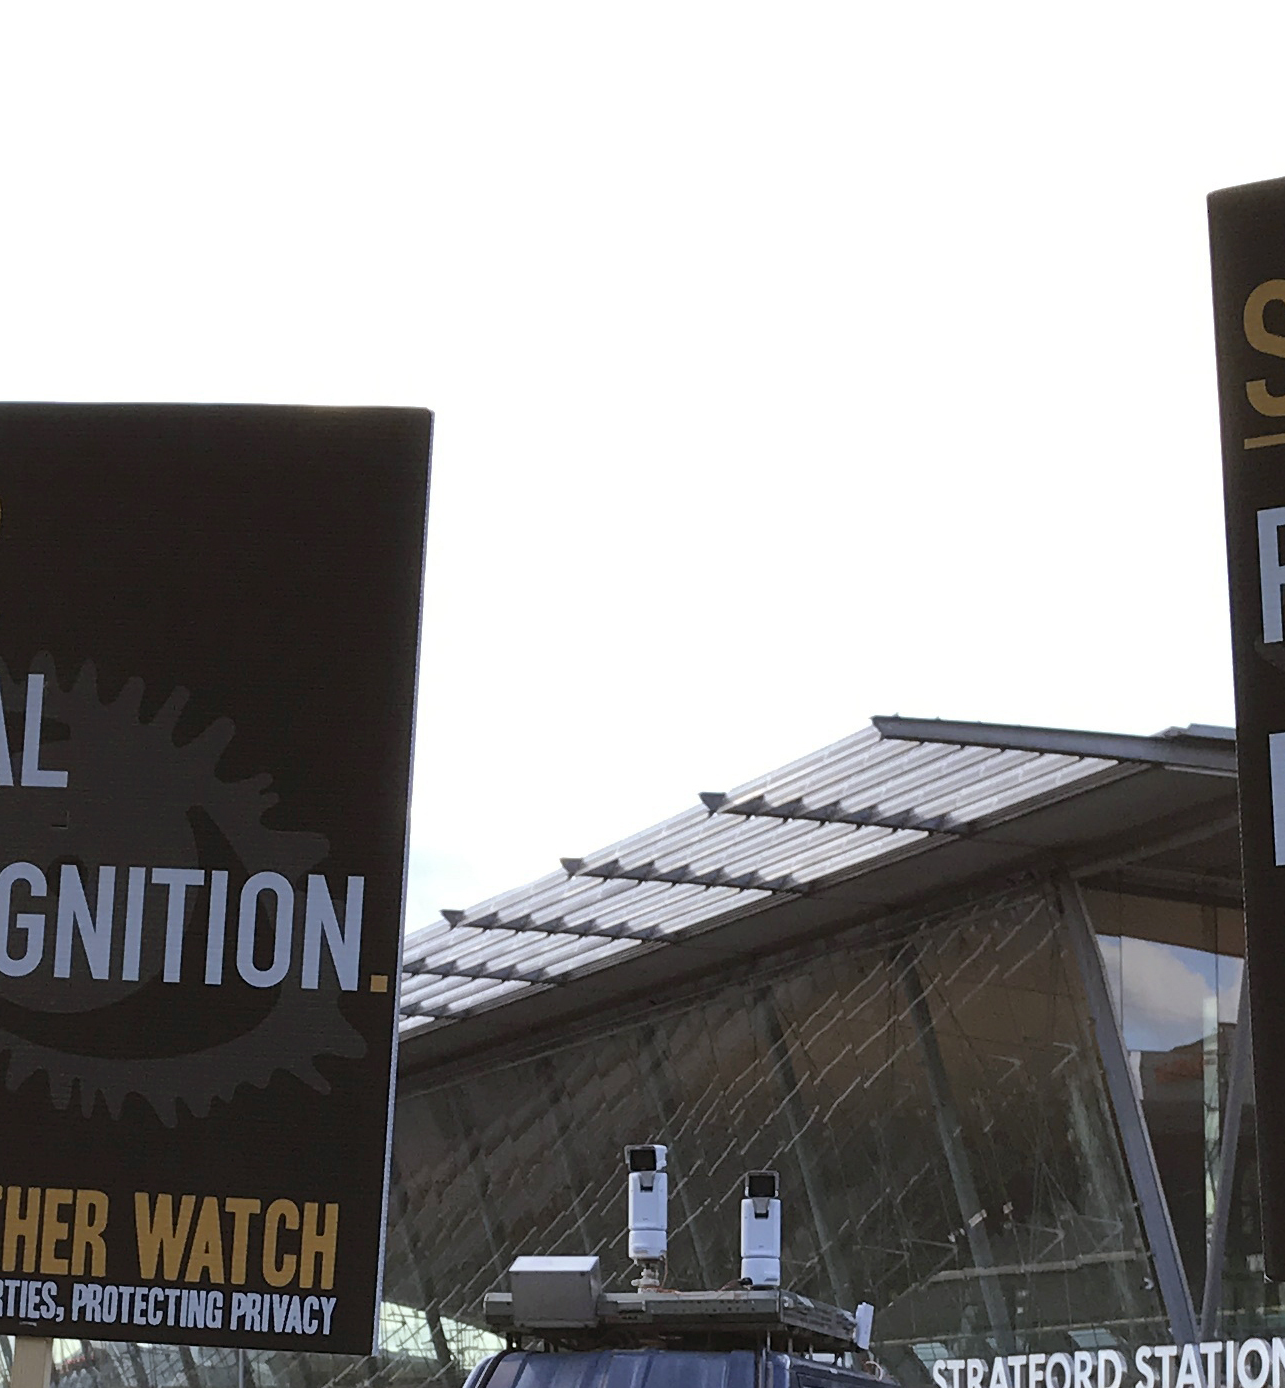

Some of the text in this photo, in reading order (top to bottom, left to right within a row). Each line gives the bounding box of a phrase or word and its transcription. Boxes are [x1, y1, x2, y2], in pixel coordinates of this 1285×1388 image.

[134, 1192, 338, 1290] WATCH
[70, 1282, 224, 1330] PROTECTING
[229, 1290, 338, 1336] PRIVACY
